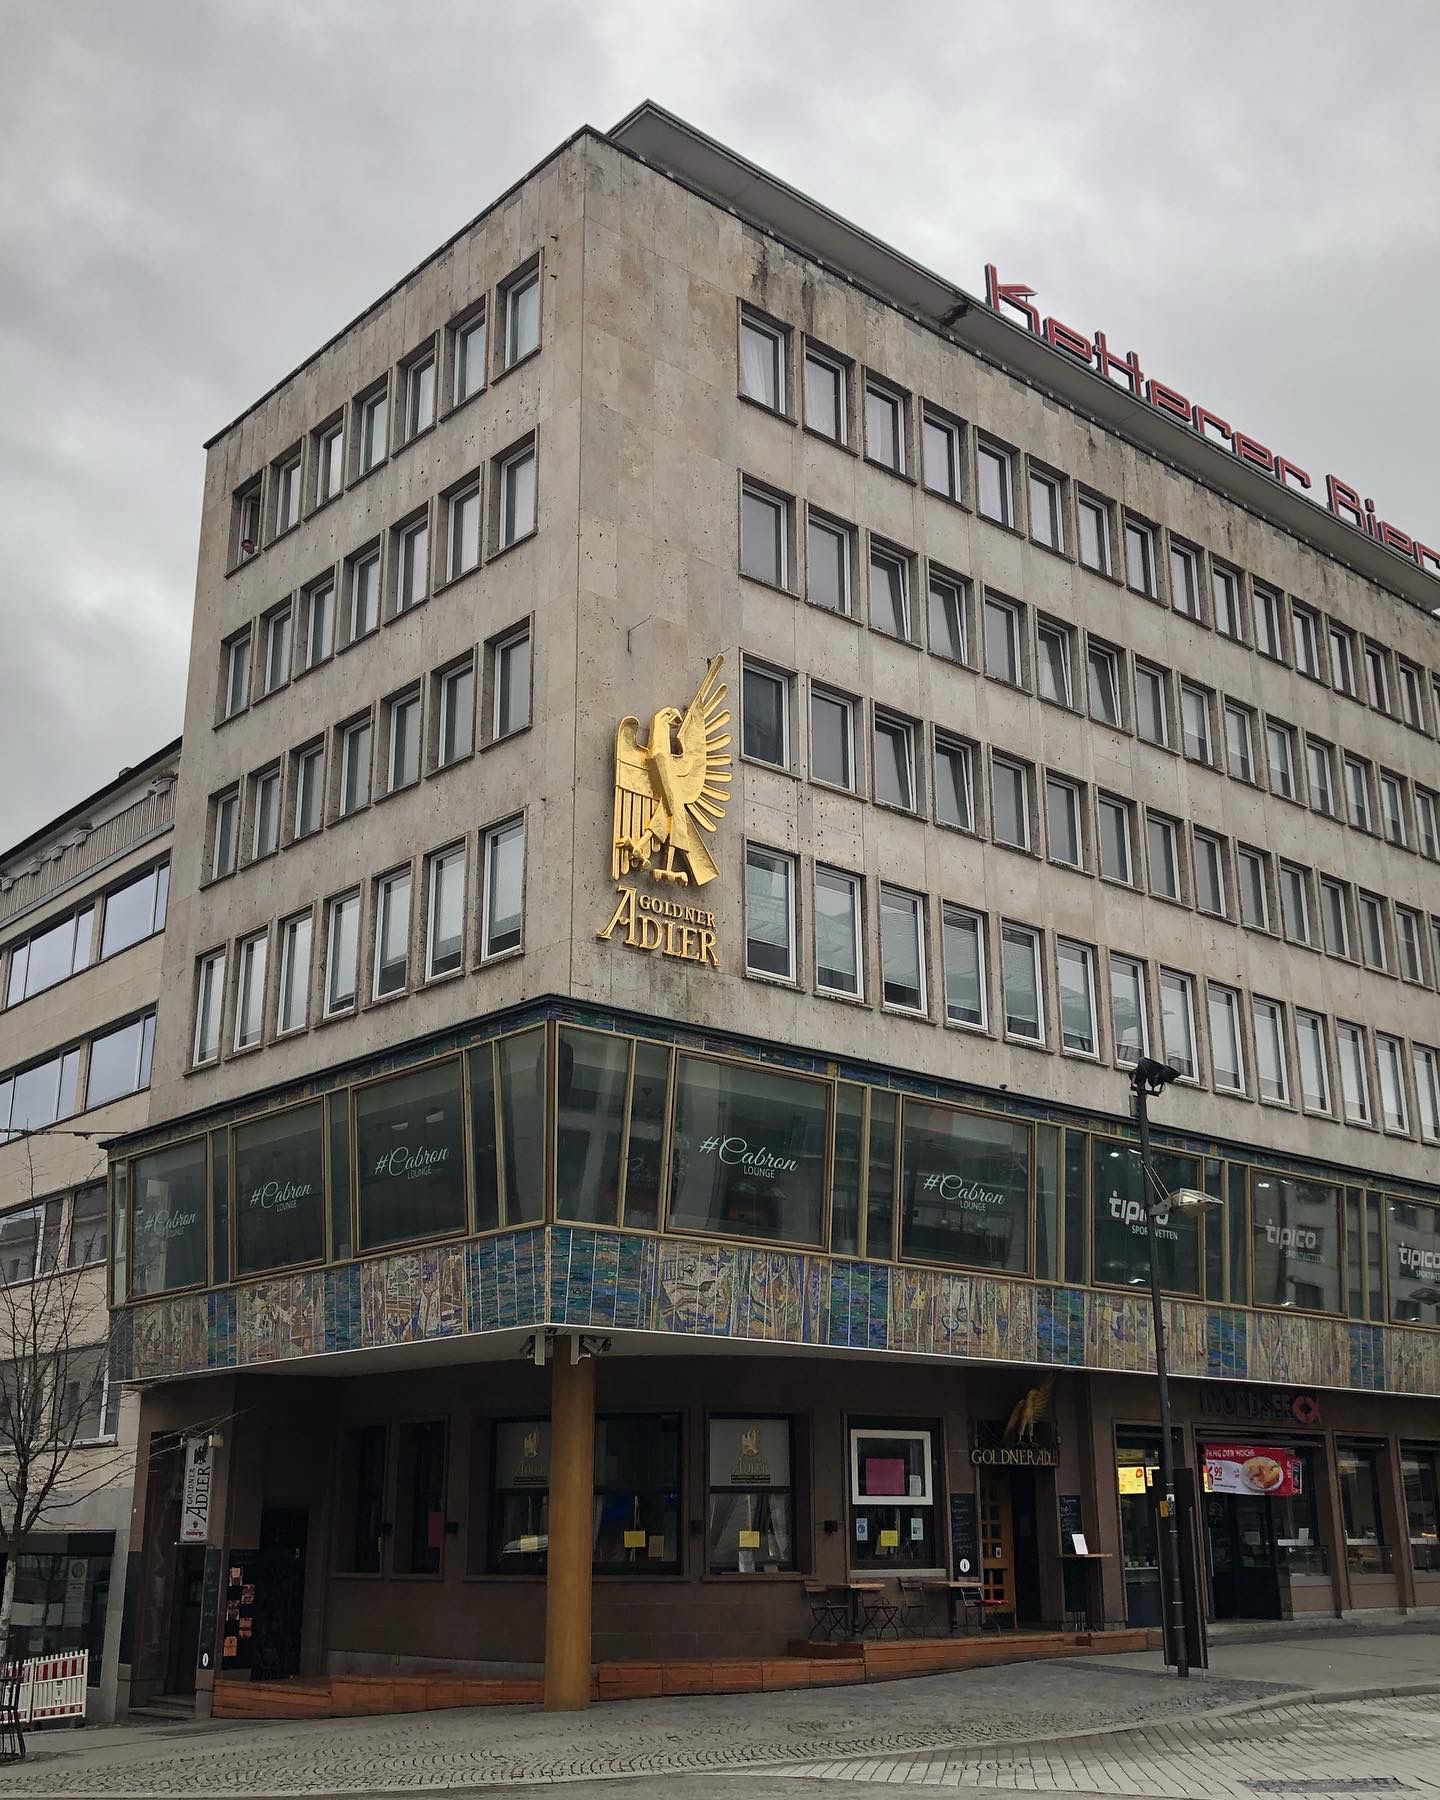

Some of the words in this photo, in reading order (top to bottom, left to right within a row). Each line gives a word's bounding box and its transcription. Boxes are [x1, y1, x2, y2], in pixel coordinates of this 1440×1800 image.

[596, 884, 721, 968] ADLER
[638, 894, 716, 928] GOLDNER
[375, 1146, 449, 1176] #Cabron
[699, 1135, 798, 1172] #Cabron
[406, 1165, 432, 1180] LOUNGE
[743, 1164, 776, 1179] LOUNGE
[249, 1180, 312, 1209] #Cabron
[923, 1172, 1006, 1205] #Cabron
[275, 1199, 298, 1213] LOUNGE
[959, 1199, 987, 1213] LOUNGE
[1108, 1189, 1169, 1226] tipio
[1265, 1218, 1317, 1250] tipico
[971, 1449, 1034, 1465] GOLDNER
[186, 1467, 196, 1505] GOLDNER
[186, 1465, 211, 1523] ADLER
